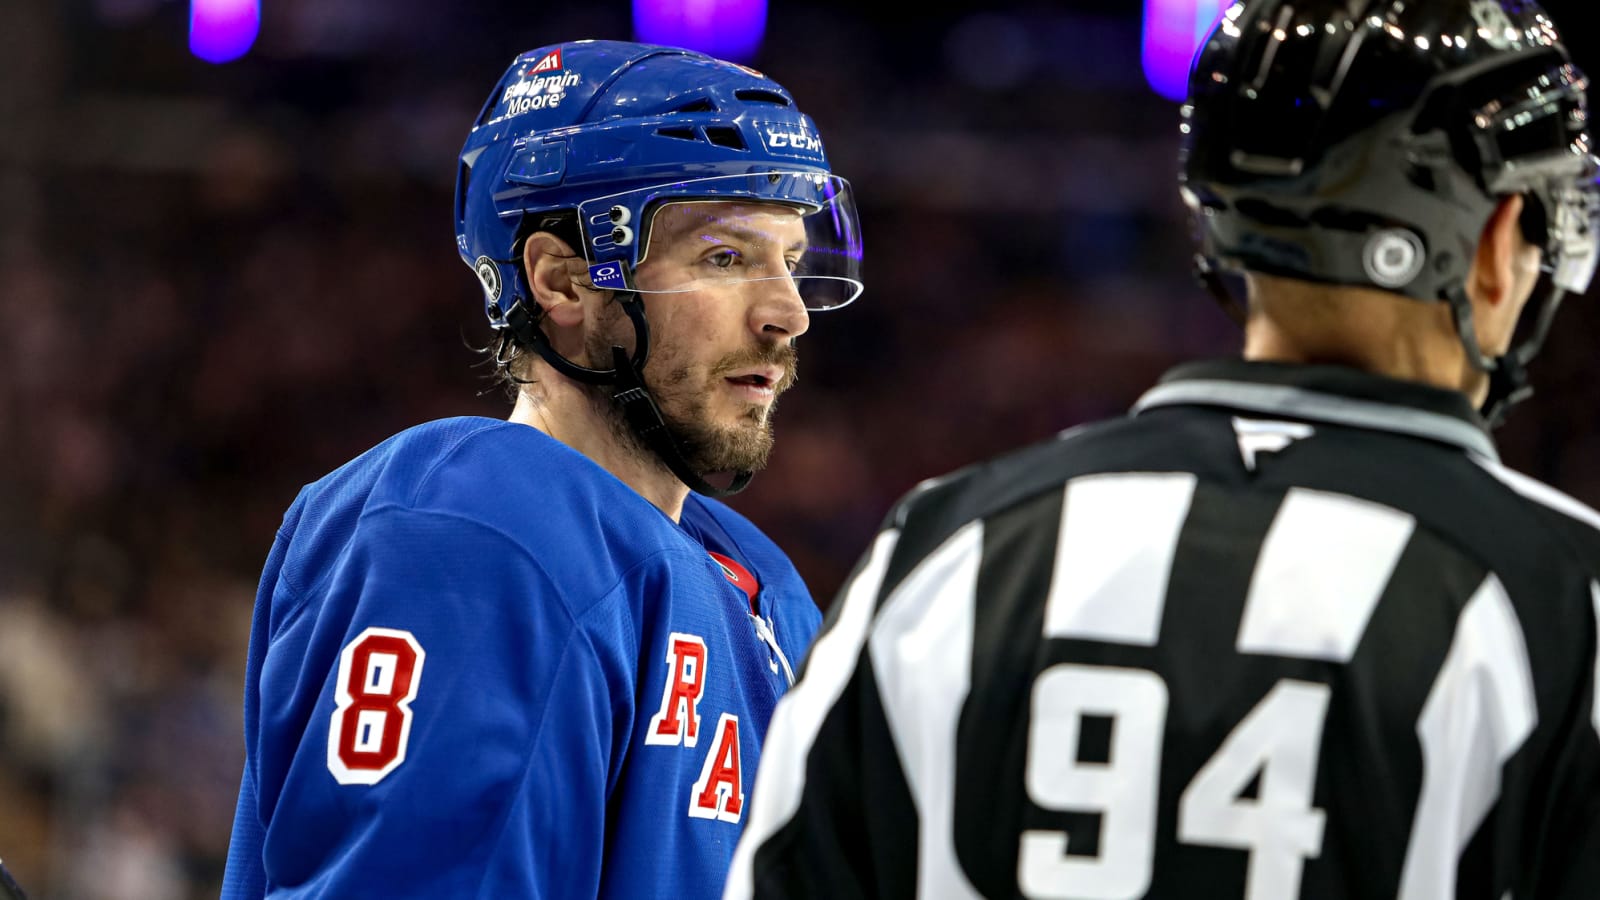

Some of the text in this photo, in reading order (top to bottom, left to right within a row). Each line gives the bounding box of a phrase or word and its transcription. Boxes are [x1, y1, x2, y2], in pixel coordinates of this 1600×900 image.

[503, 70, 580, 103] Bnjamin
[507, 93, 560, 115] Moore
[769, 132, 819, 152] CCM
[327, 626, 426, 786] 8
[1018, 662, 1331, 900] 94
